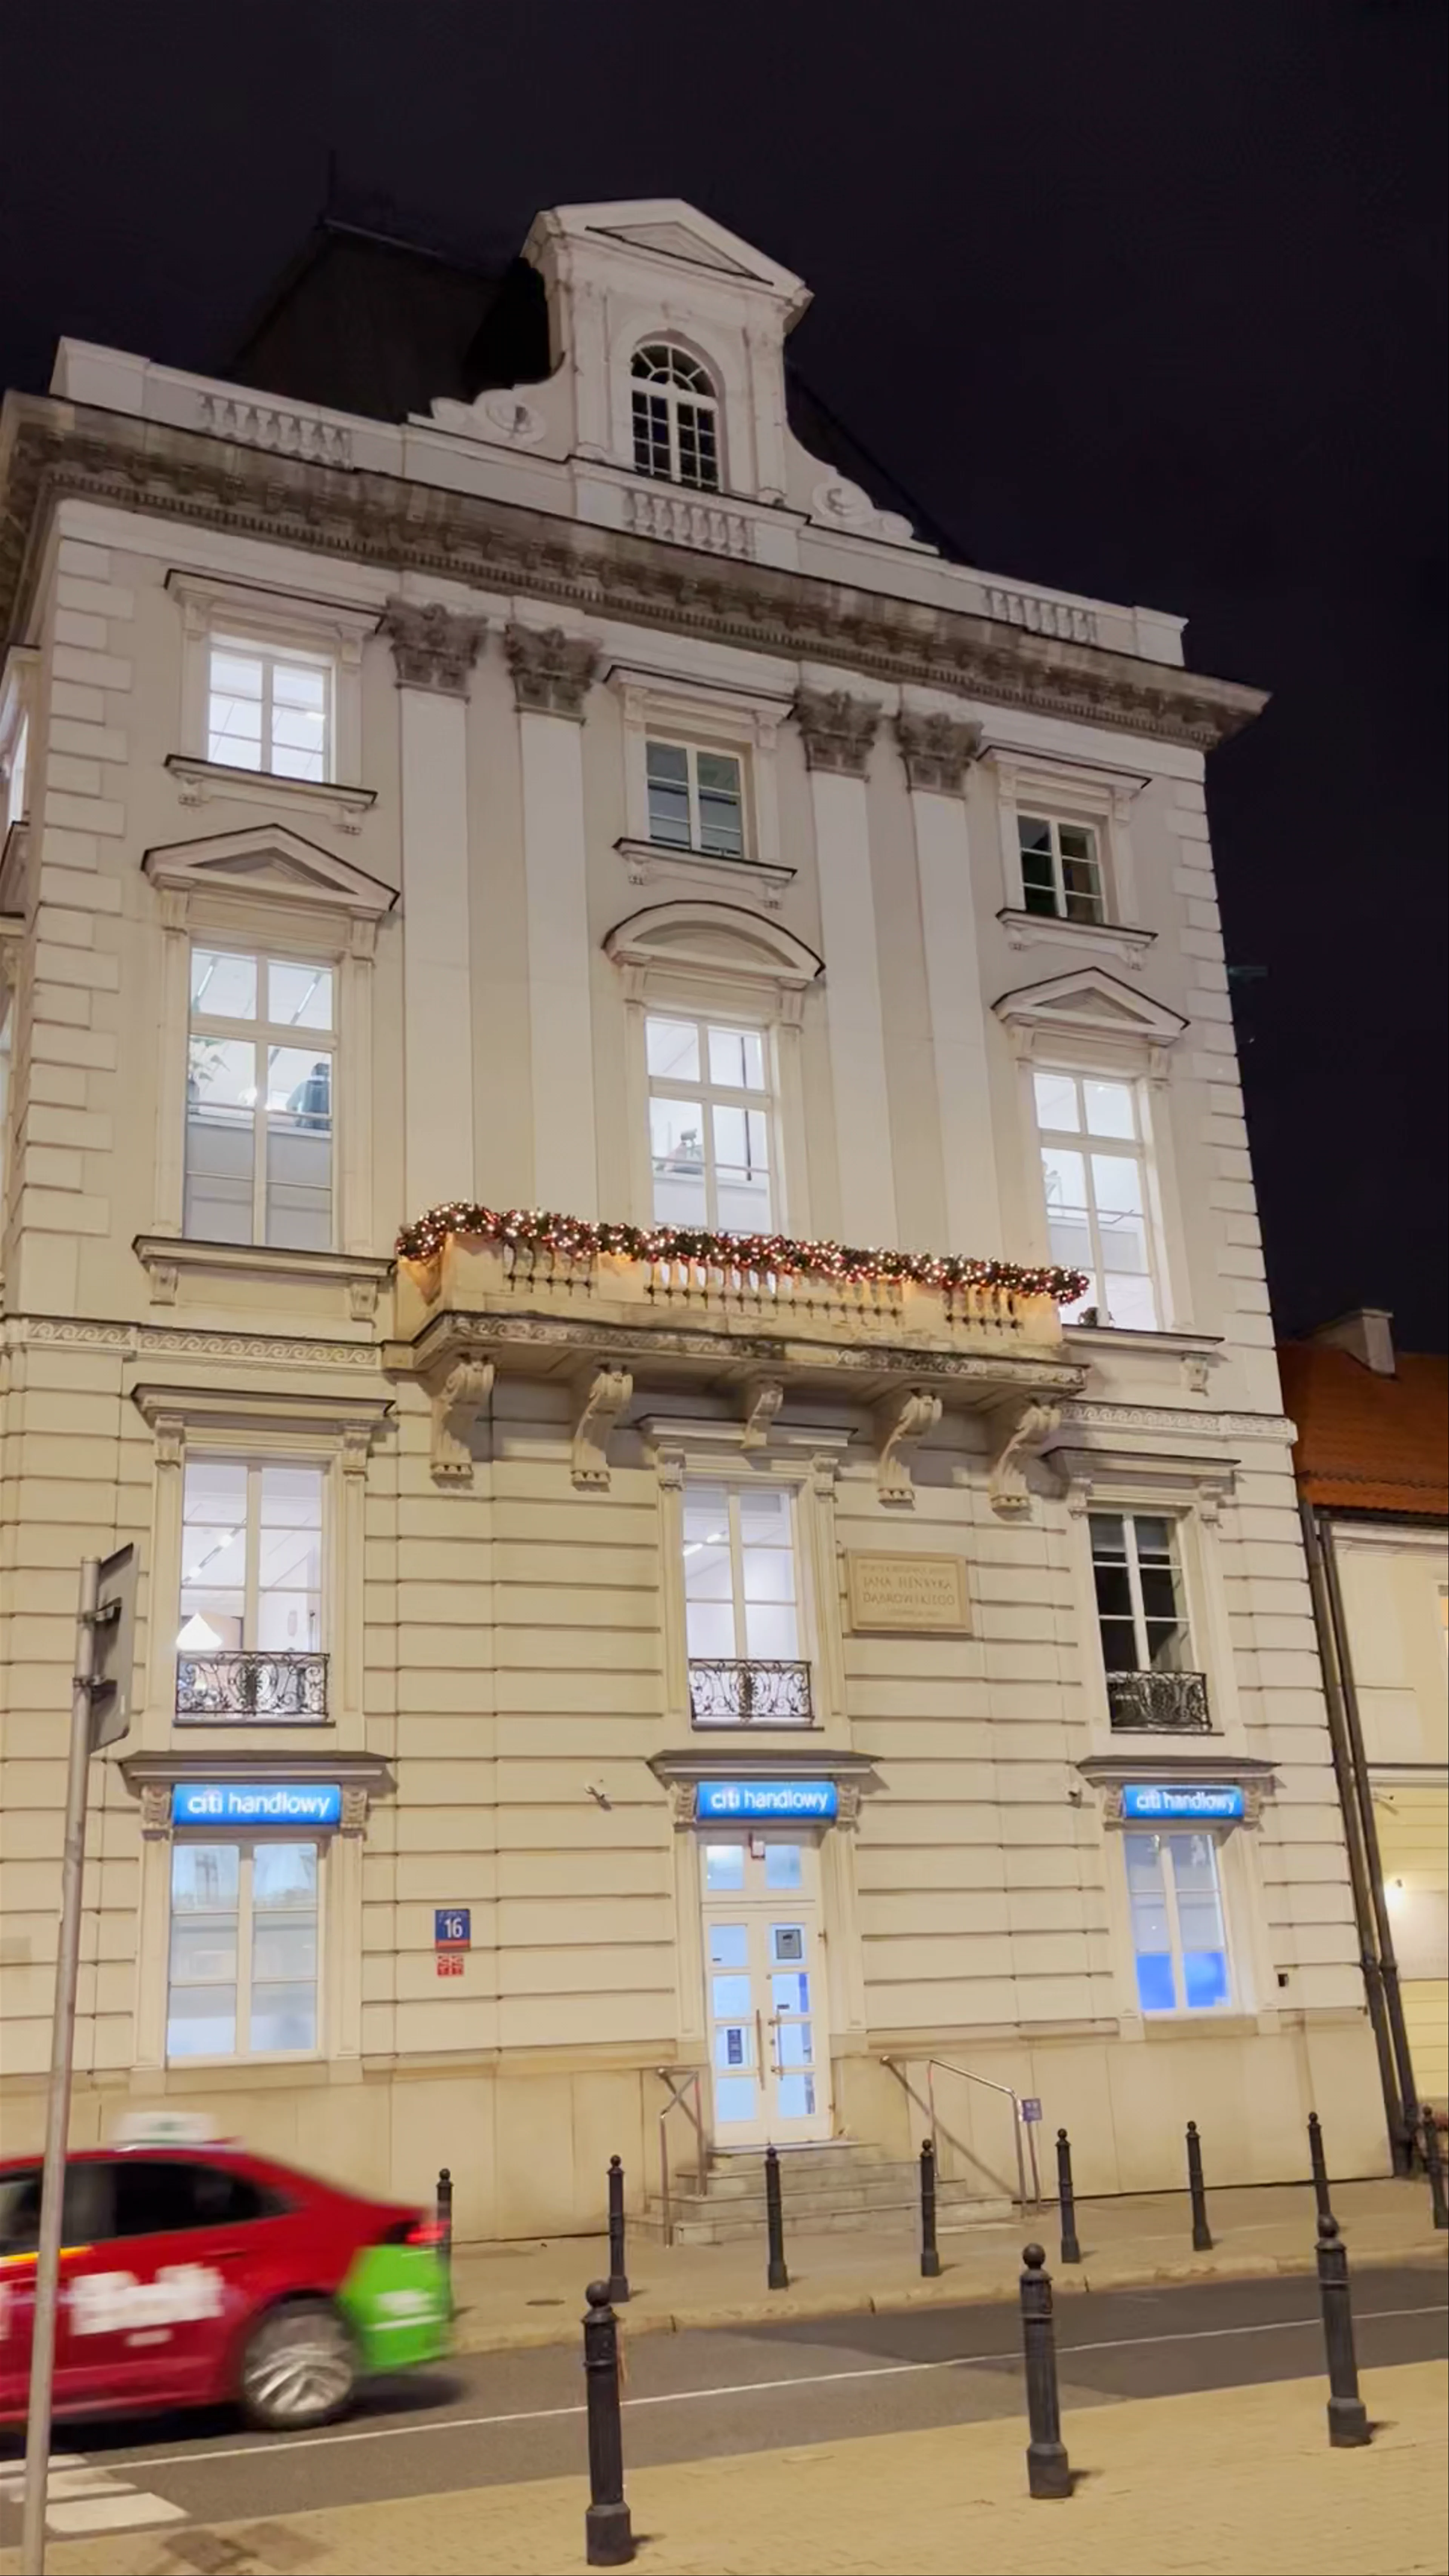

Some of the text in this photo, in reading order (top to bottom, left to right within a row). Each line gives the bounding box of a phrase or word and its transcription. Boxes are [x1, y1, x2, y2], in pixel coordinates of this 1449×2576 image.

[188, 1790, 331, 1818] citi handlowy
[710, 1789, 829, 1811] citi handlowy
[1136, 1789, 1237, 1814] citi handlowy
[444, 1917, 463, 1938] 16
